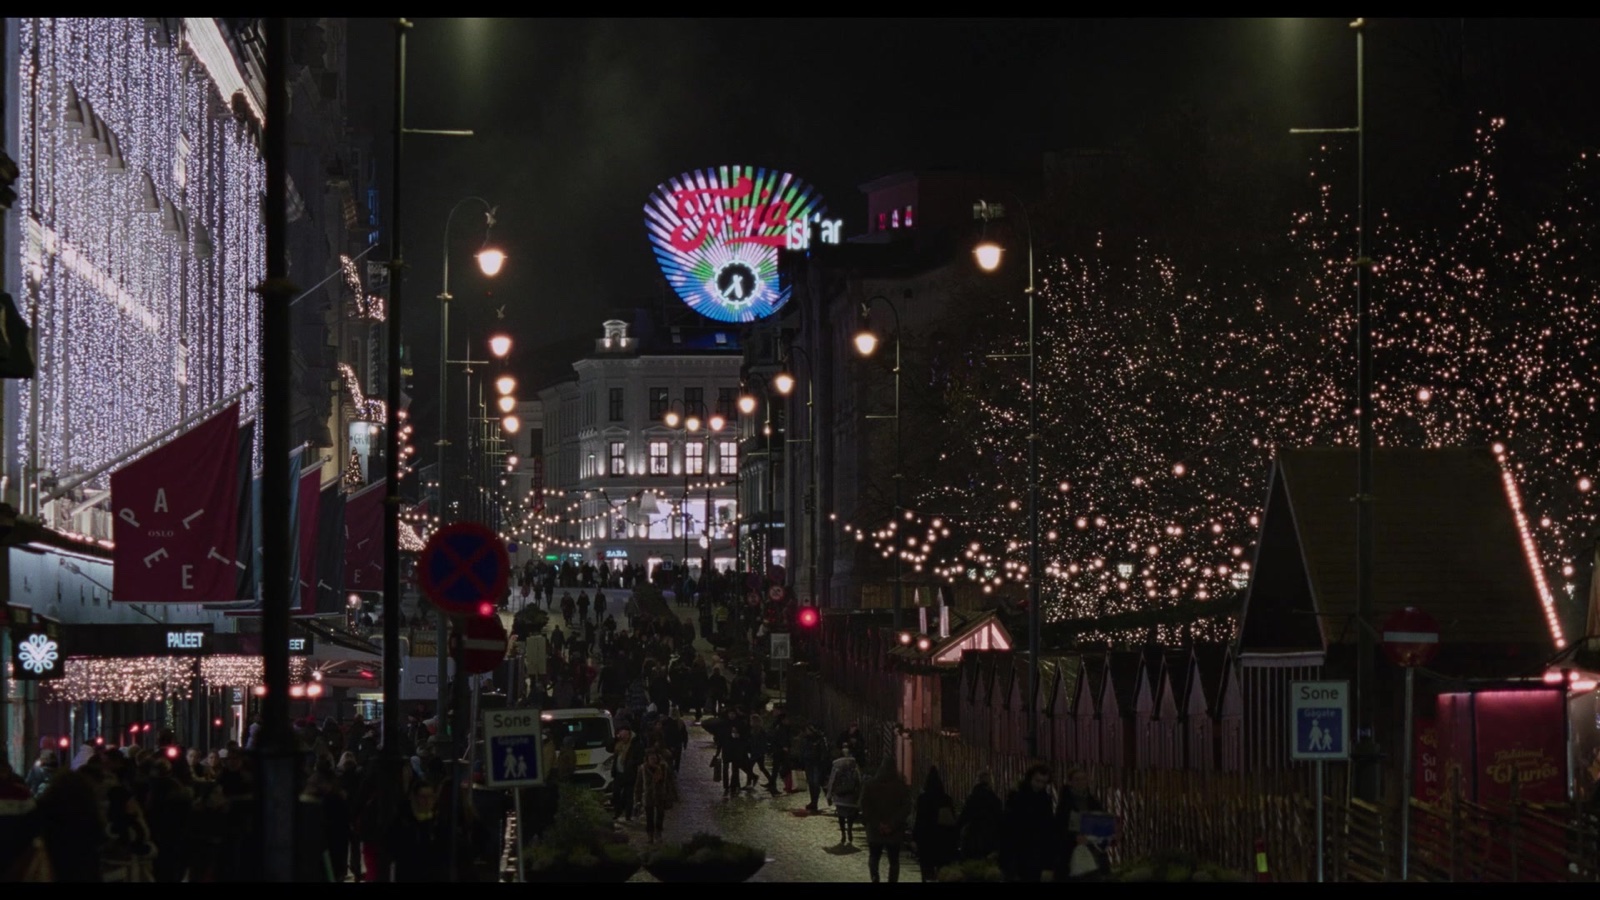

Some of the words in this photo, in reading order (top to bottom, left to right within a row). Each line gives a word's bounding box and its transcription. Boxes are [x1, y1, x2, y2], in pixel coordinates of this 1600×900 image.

[671, 177, 791, 252] Freia
[606, 550, 628, 558] ZARA
[166, 632, 204, 648] PALEET
[288, 638, 306, 650] EET
[1300, 686, 1339, 700] Sone
[493, 713, 531, 728] Sone
